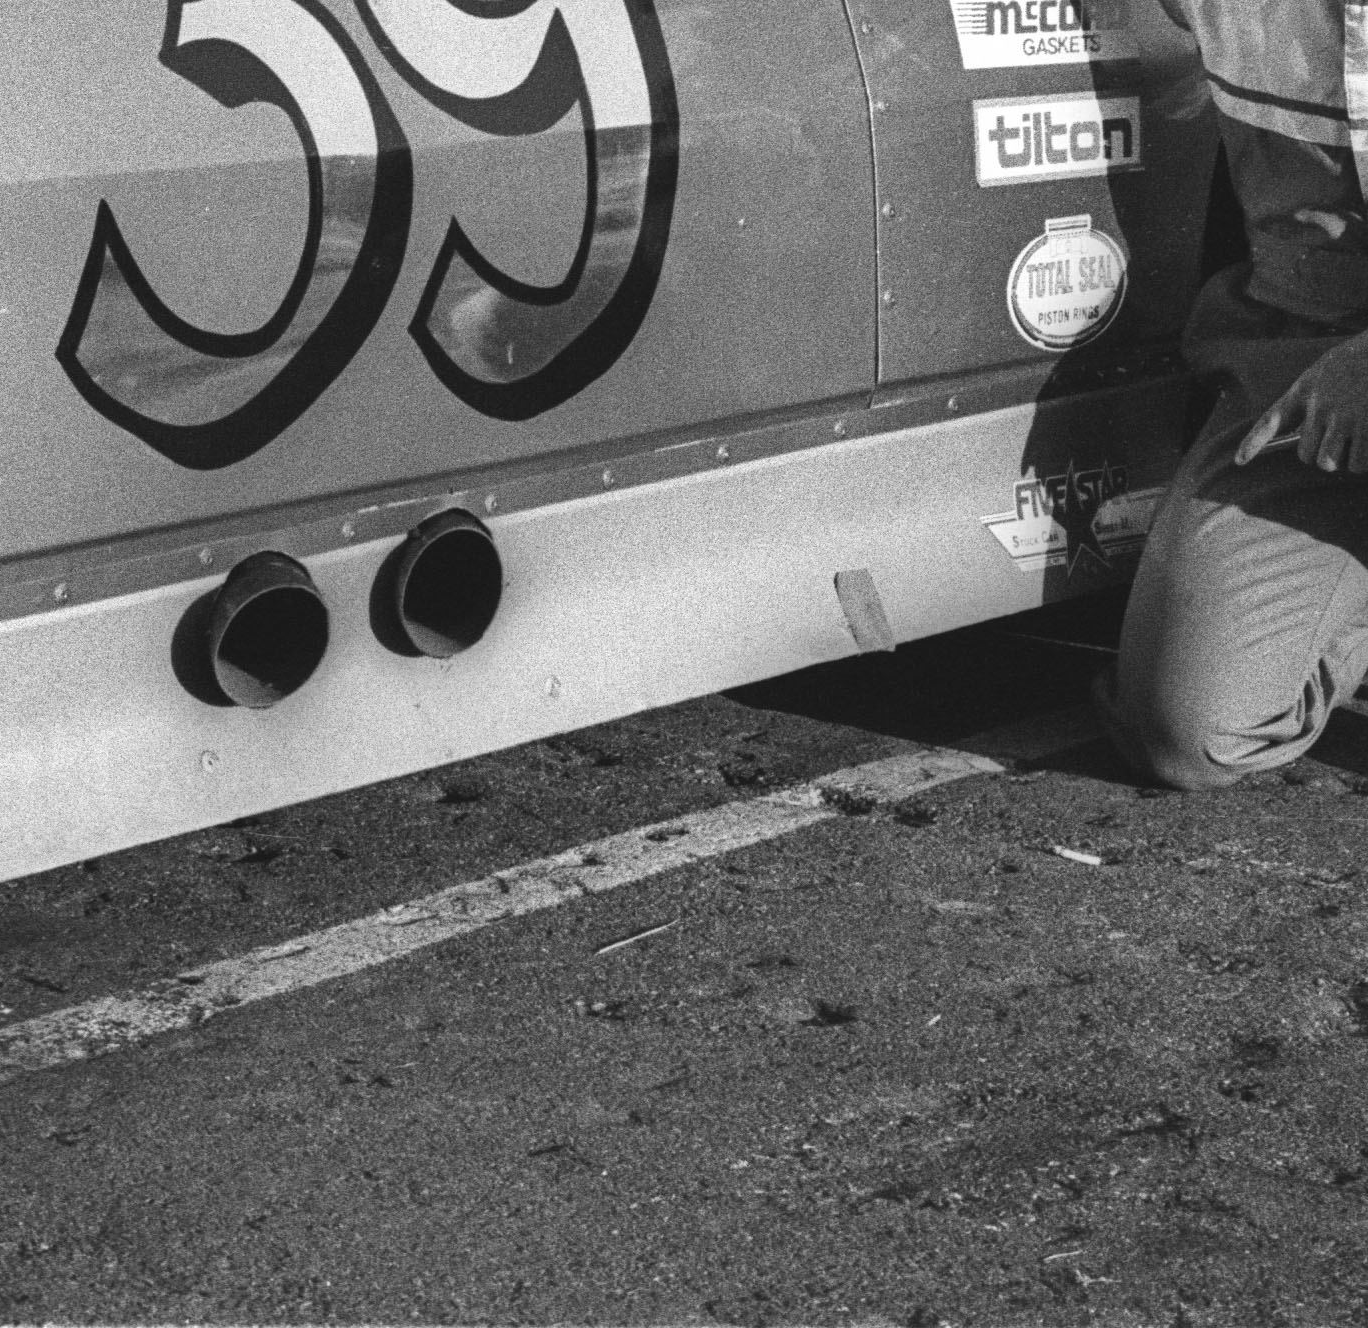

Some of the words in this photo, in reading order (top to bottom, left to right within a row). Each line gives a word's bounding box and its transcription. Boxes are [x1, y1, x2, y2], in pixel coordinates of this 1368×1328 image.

[1022, 34, 1101, 57] GASKETS
[988, 111, 1131, 168] tilton
[1026, 258, 1074, 299] TOTAL
[1078, 253, 1116, 293] SEAL
[1038, 309, 1070, 326] PISTON
[1015, 477, 1067, 521] FIVE
